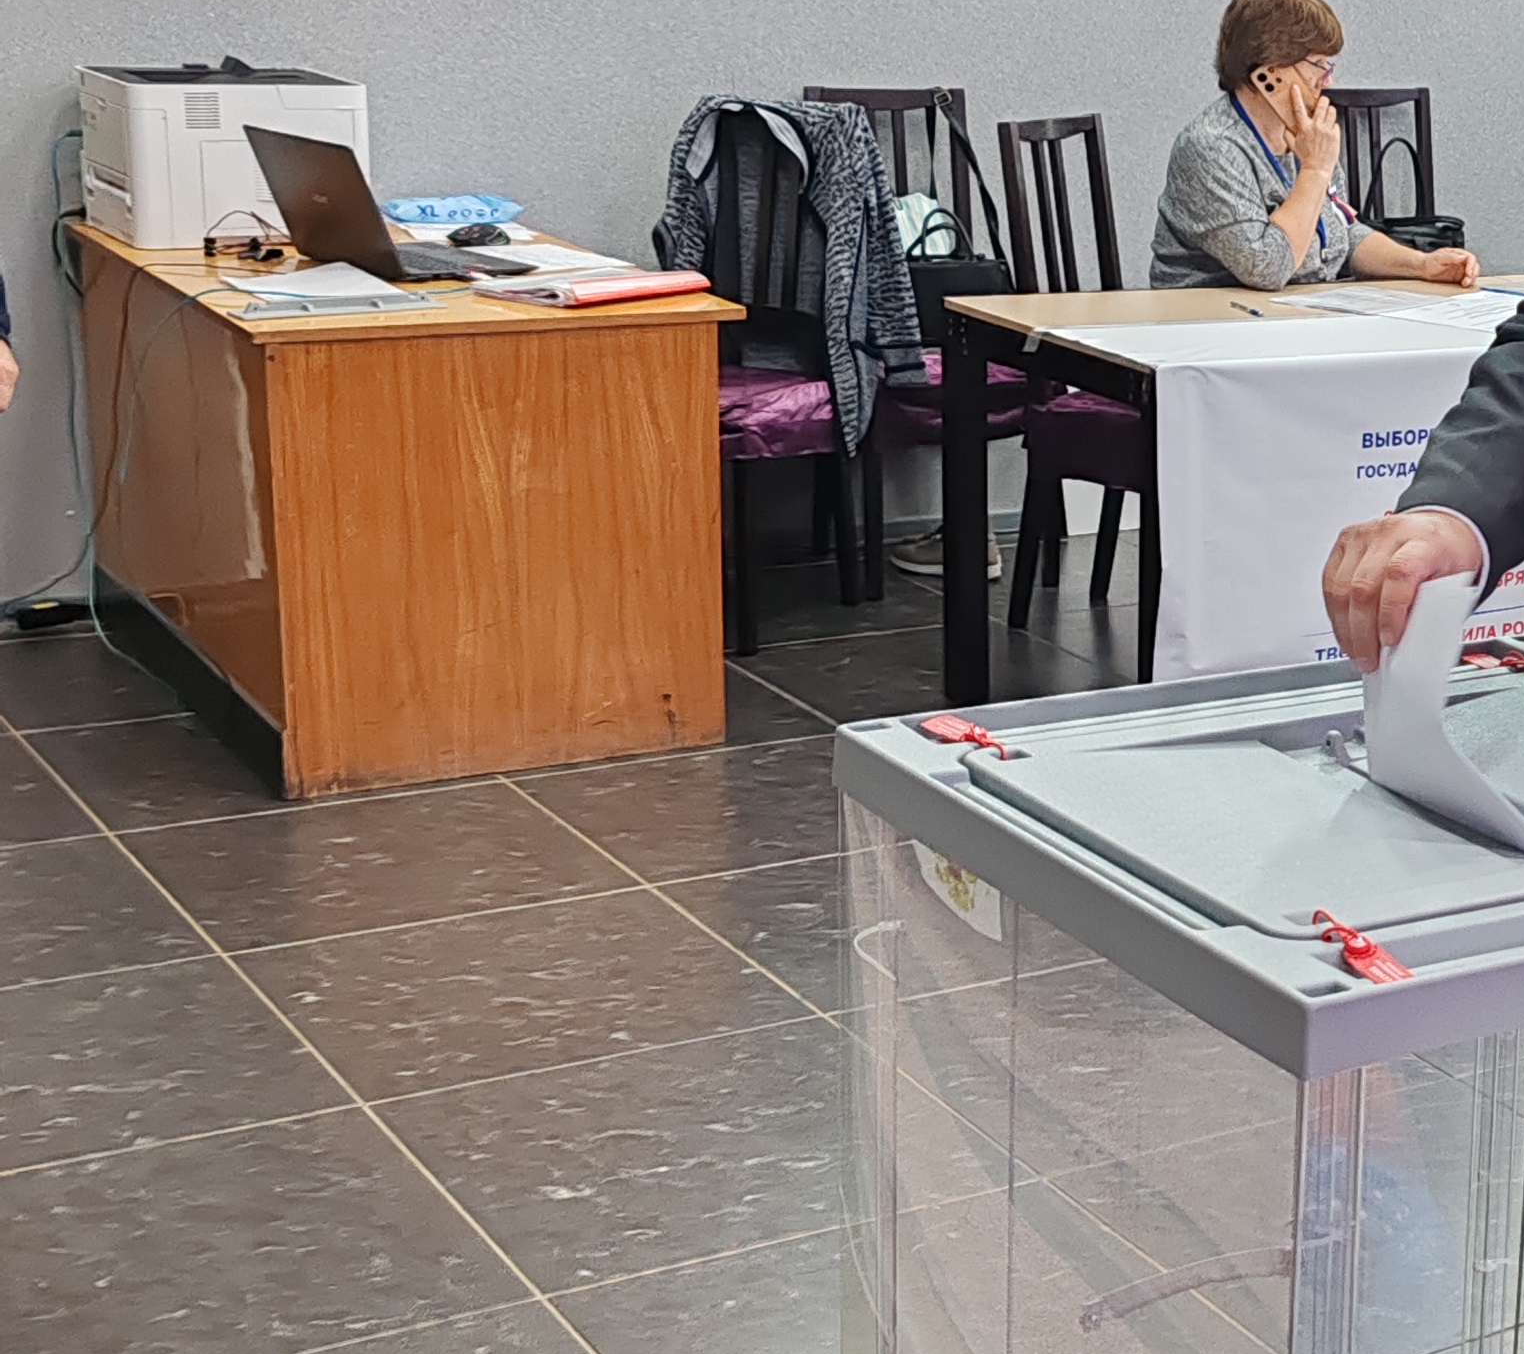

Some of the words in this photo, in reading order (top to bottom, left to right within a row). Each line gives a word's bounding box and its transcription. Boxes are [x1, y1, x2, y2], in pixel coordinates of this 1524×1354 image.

[1362, 429, 1429, 449] ВЫБОР
[1356, 462, 1418, 479] ГОСУДА
[1461, 625, 1497, 642] ИЛА
